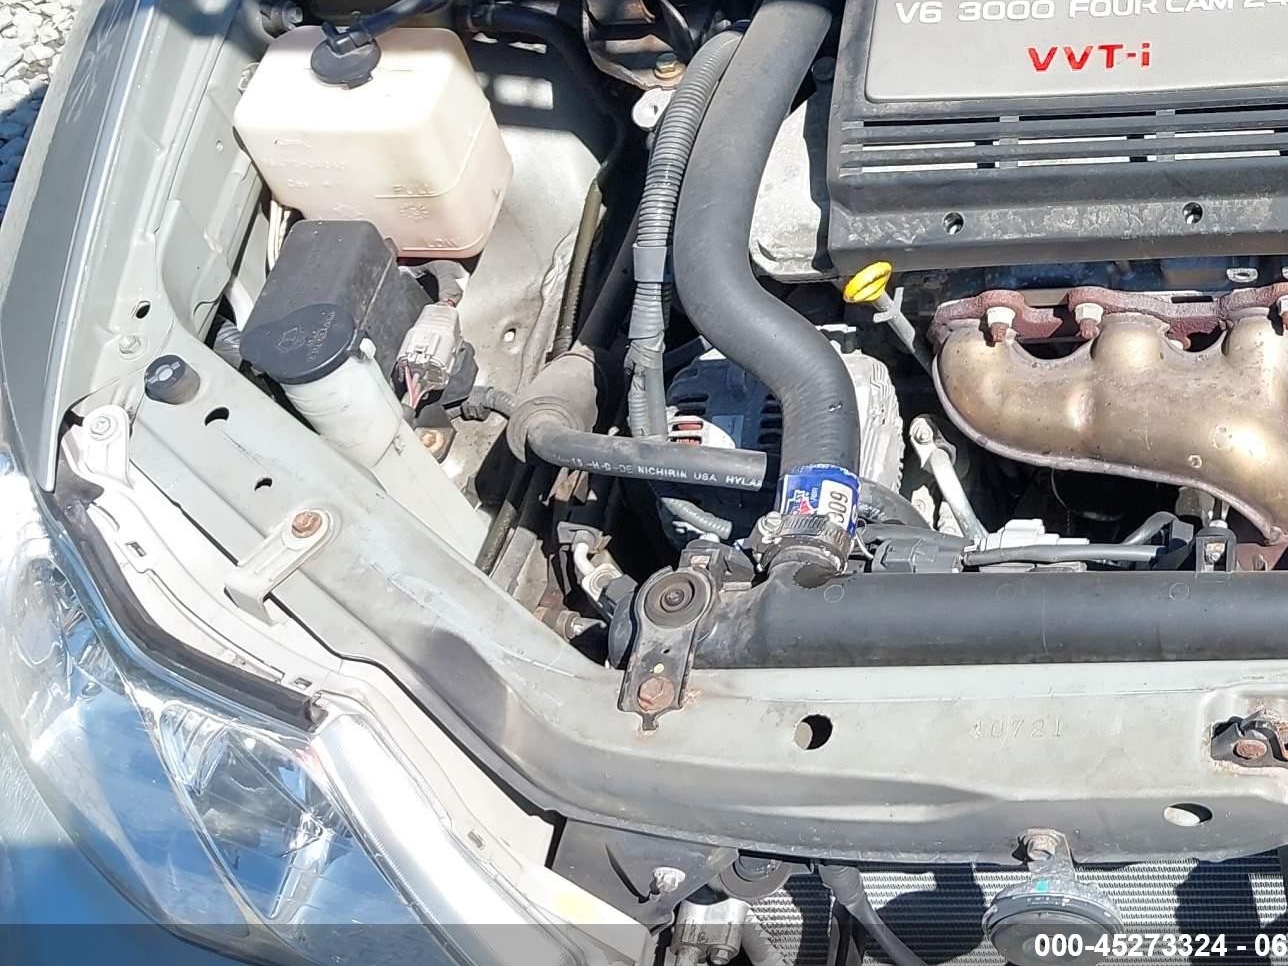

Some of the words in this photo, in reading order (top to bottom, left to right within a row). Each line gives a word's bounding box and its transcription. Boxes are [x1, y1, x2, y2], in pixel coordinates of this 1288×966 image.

[895, 1, 943, 24] V6
[957, 0, 1054, 22] 3000
[1026, 42, 1152, 72] VVT-i
[638, 465, 687, 479] NICHIRIN
[693, 472, 717, 482] USA
